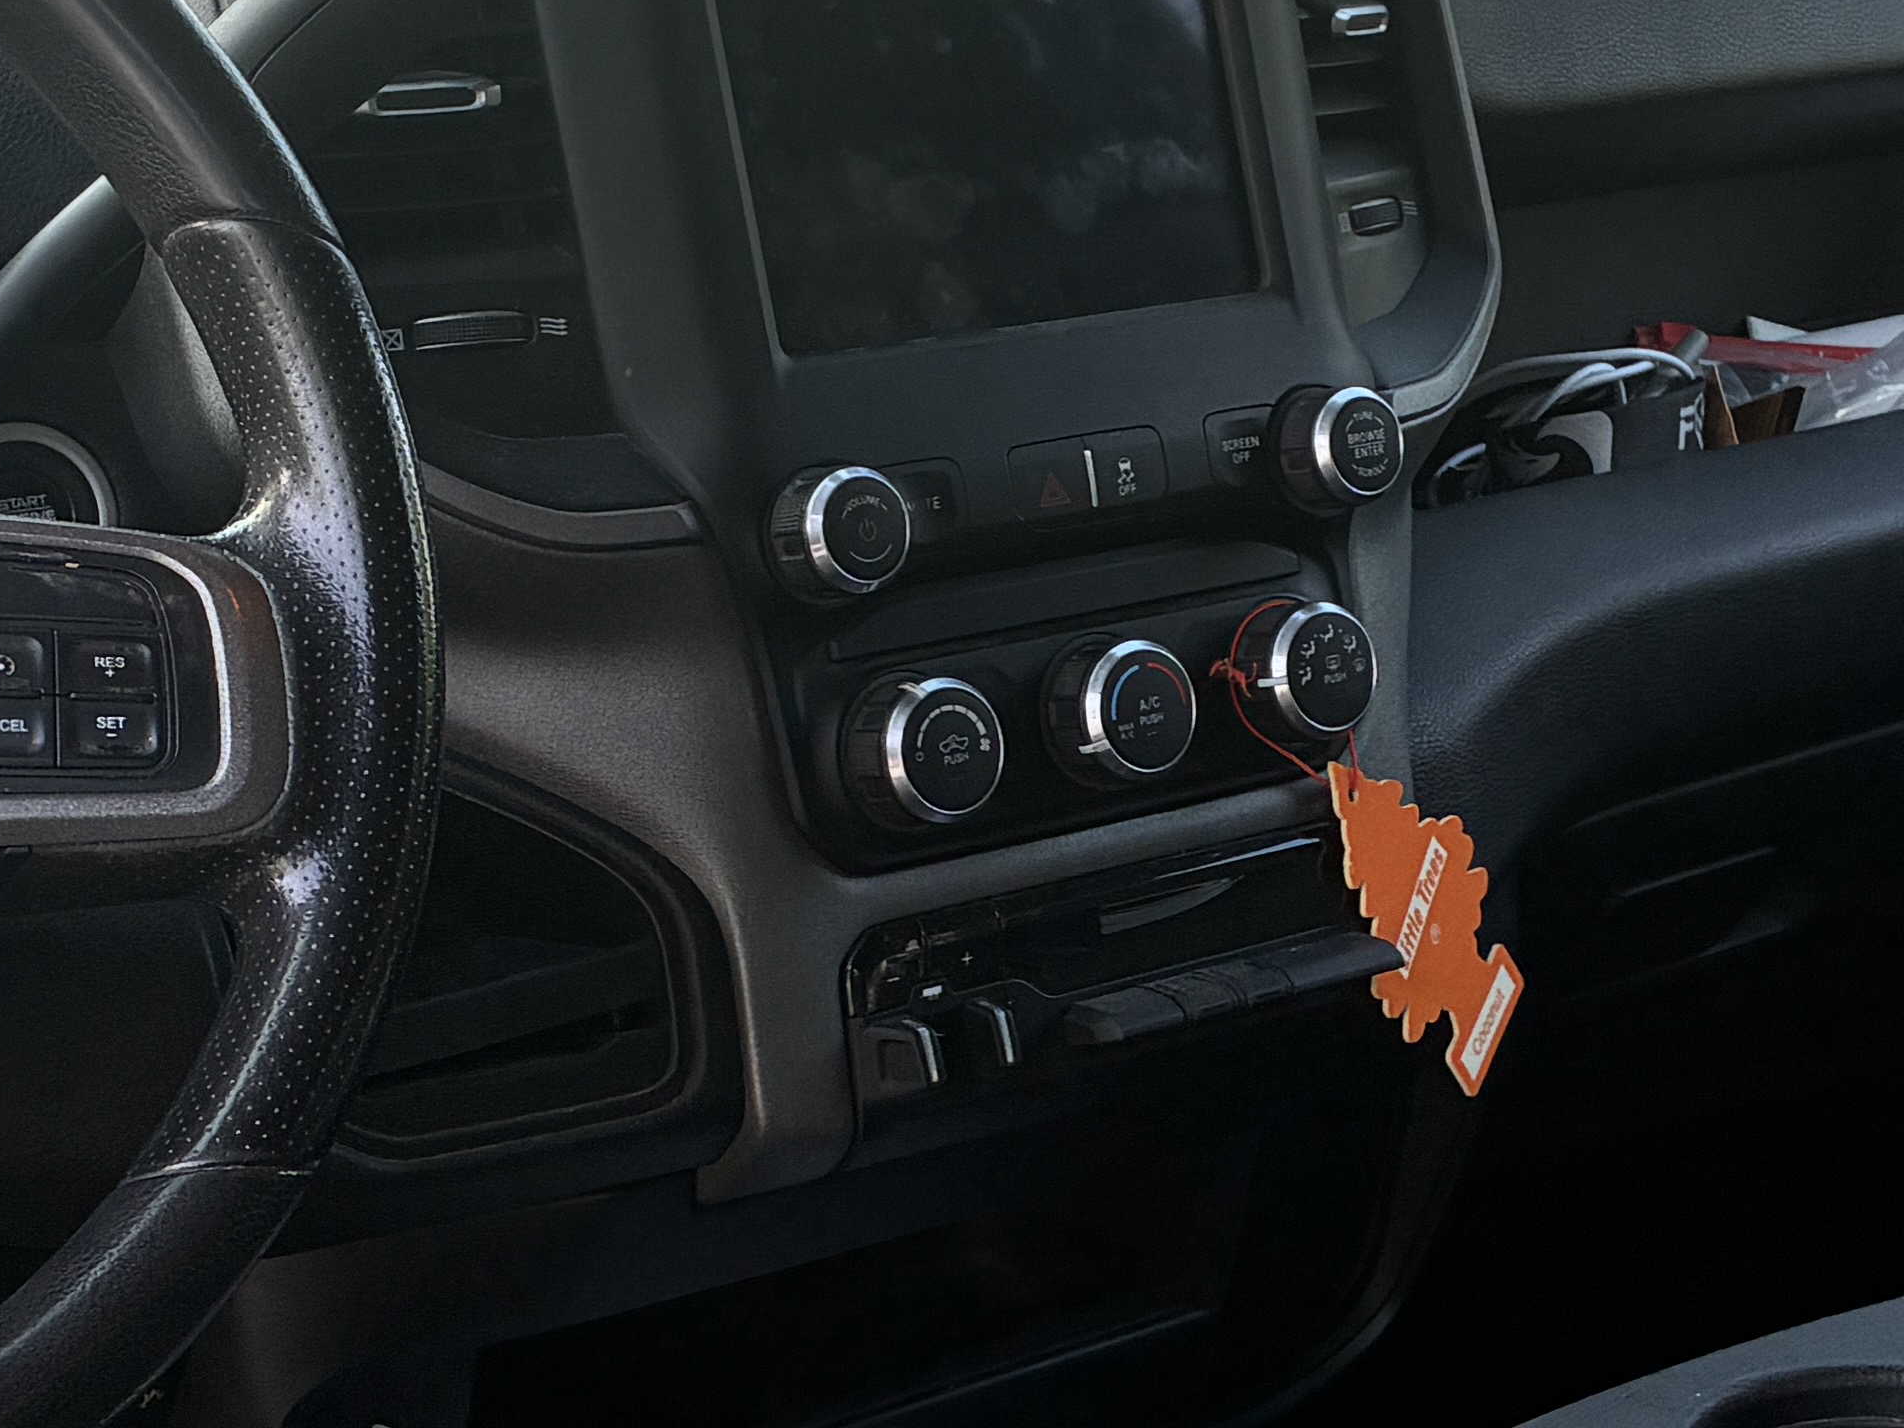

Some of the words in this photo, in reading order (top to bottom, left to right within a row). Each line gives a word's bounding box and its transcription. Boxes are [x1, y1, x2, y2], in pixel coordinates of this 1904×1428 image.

[1222, 435, 1260, 452] SCREEN
[1348, 429, 1386, 445] BROWSE
[1232, 451, 1251, 464] OFF
[1354, 443, 1385, 459] ENTER
[1119, 483, 1136, 496] OFF
[847, 495, 881, 512] VOLUME
[94, 656, 125, 669] RES
[1139, 695, 1161, 712] A/C
[96, 716, 127, 730] SET
[1415, 848, 1445, 906] Trees
[1471, 987, 1506, 1057] Coconut
